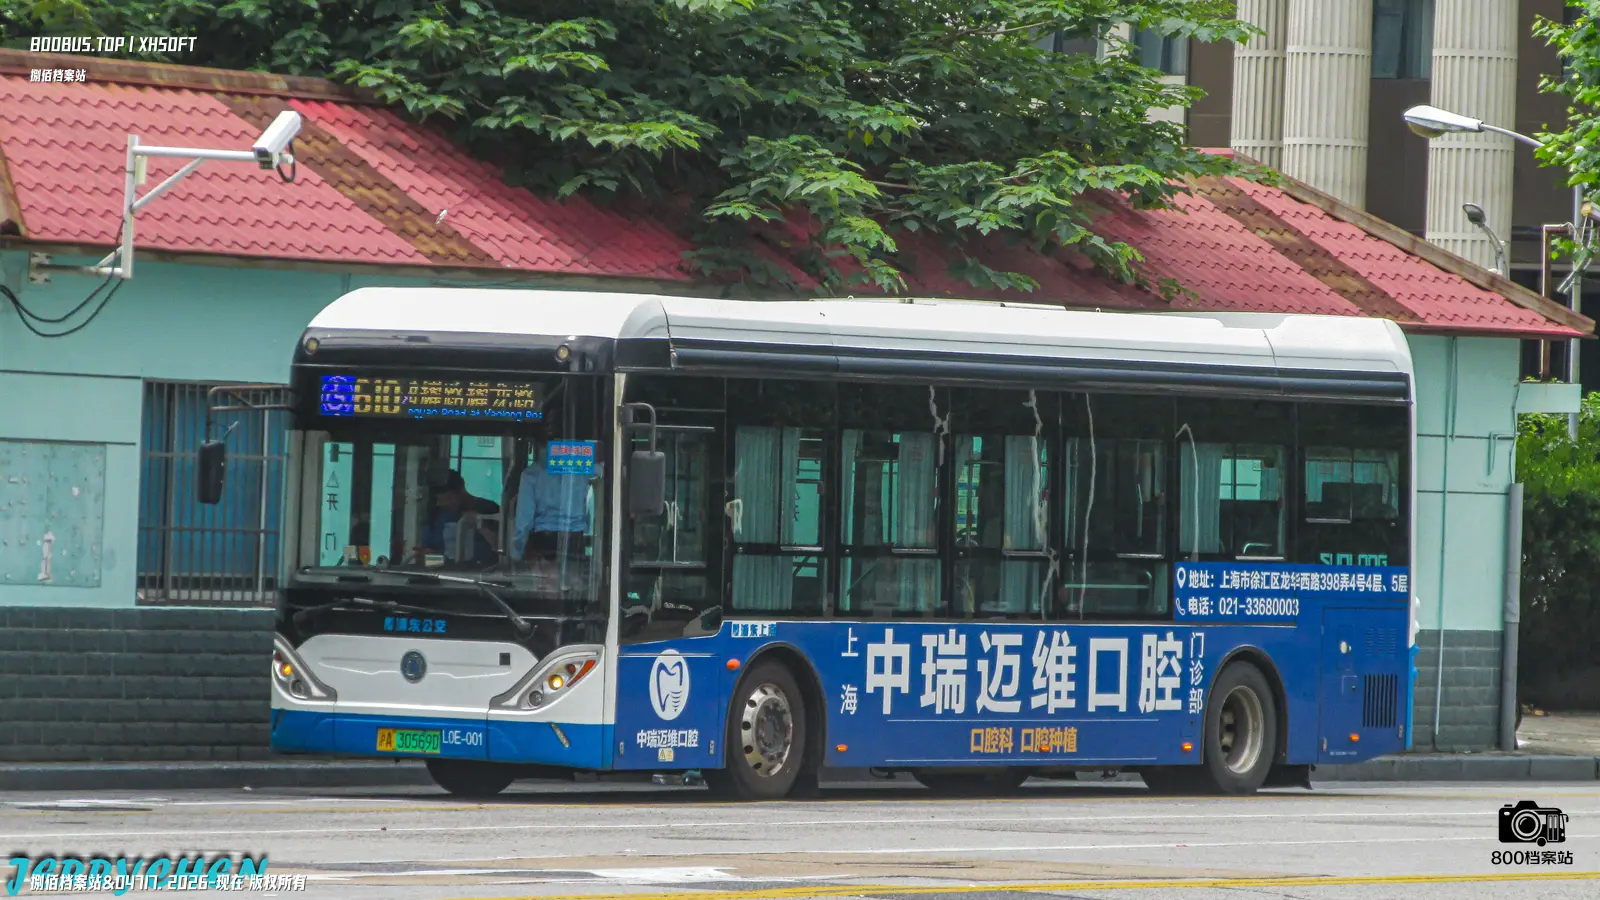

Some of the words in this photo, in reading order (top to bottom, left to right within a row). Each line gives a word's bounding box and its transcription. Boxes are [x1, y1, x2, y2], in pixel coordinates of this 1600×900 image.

[866, 627, 1183, 715] 中瑞迈维口腔
[1189, 632, 1205, 715] 门诊部
[637, 729, 698, 748] 中瑞迈维口腔
[970, 727, 1013, 753] 口腔科
